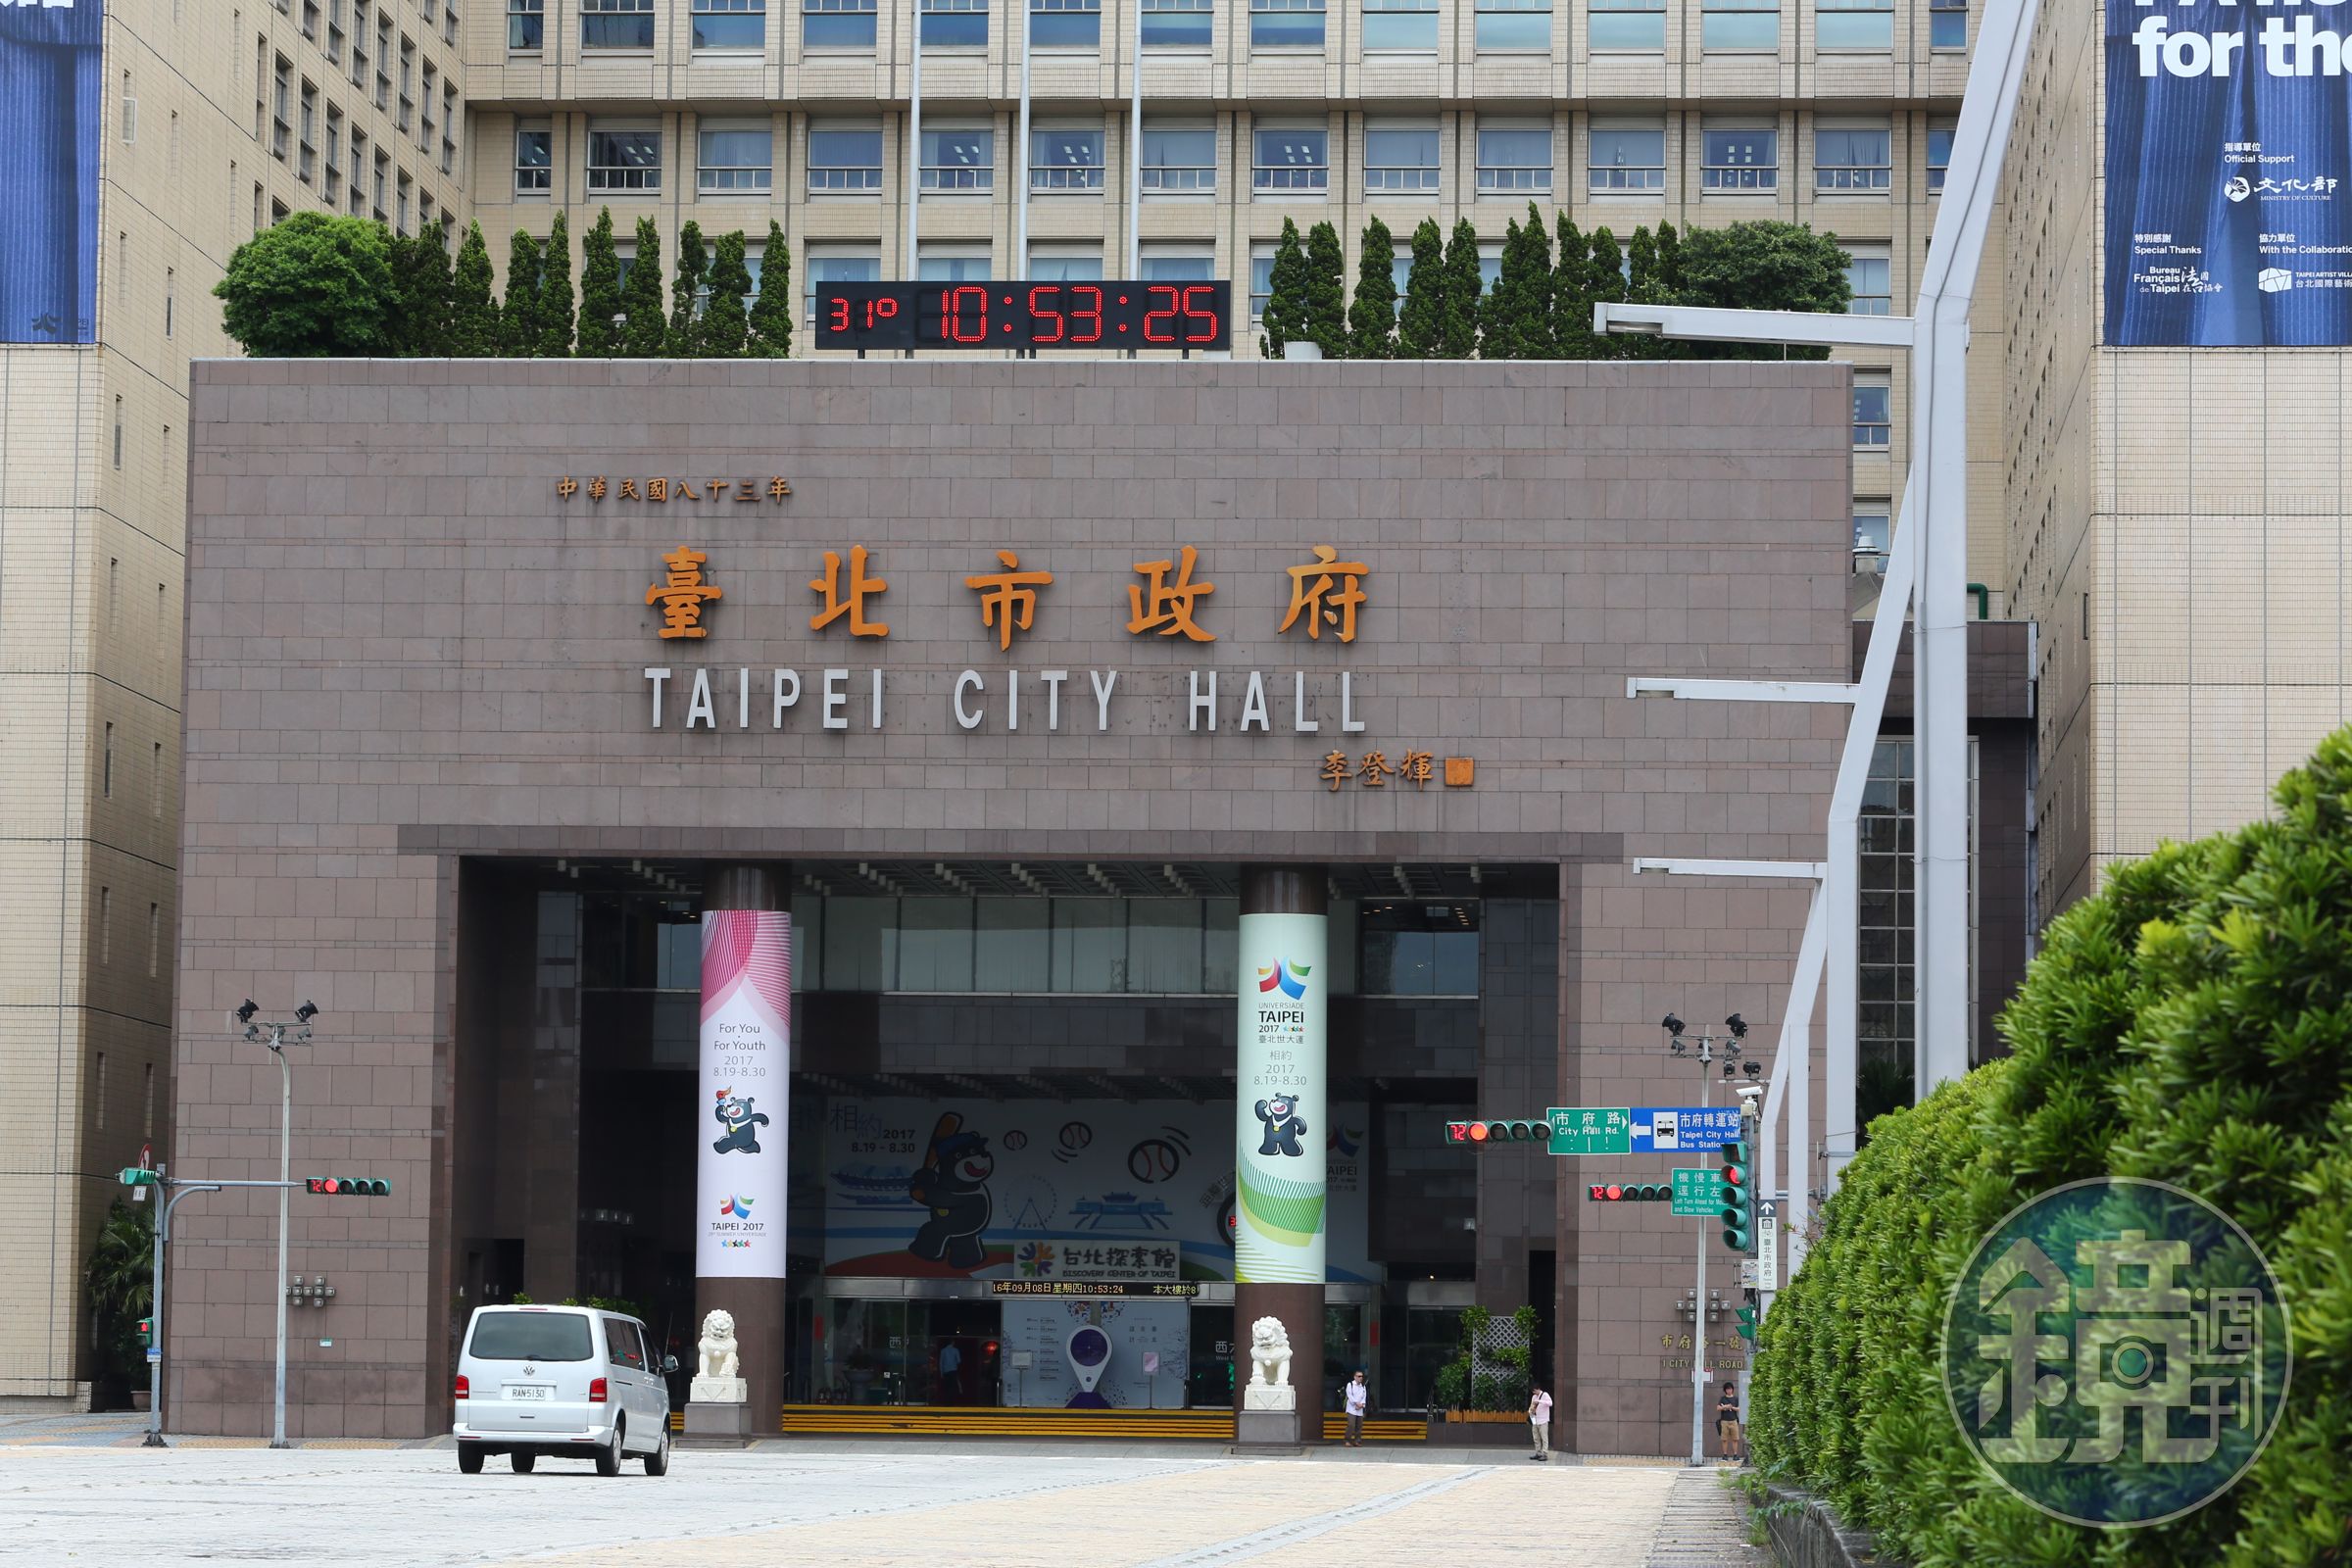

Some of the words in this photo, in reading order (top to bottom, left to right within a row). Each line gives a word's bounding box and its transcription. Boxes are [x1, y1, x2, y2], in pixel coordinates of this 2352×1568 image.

[2132, 15, 2244, 78] for
[2258, 15, 2352, 78] th
[2224, 142, 2262, 152] 指導單位
[2224, 154, 2256, 163] Official
[2258, 154, 2295, 165] Support
[2253, 176, 2338, 194] 文化部
[2134, 233, 2172, 243] 特別感謝
[2259, 233, 2296, 243] 協力單位
[2134, 245, 2168, 255] Special
[2169, 245, 2202, 254] Thanks
[2259, 245, 2280, 254] With
[2281, 245, 2297, 254] the
[2133, 273, 2180, 284] Français
[2150, 283, 2180, 294] Taipei
[941, 285, 1218, 343] 10:53:25
[558, 475, 792, 505] 中華民國八十三年
[645, 544, 1370, 652] 臺北市政府
[645, 667, 882, 729] TAIPEI
[954, 668, 1118, 731] CITY
[1189, 669, 1365, 732] HALL
[1320, 748, 1435, 792] 李登輝
[1257, 1010, 1304, 1023] TAIPEI
[719, 1023, 736, 1034] For
[738, 1023, 760, 1034] You
[1258, 1024, 1280, 1033] 2017
[1258, 1034, 1305, 1045] 臺北世大運
[713, 1040, 730, 1051] For
[732, 1040, 766, 1051] Youth
[723, 1055, 754, 1065] 2017
[1269, 1050, 1293, 1061] 相約
[712, 1066, 766, 1077] 8.19-8.30
[1265, 1063, 1296, 1074] 2017
[1253, 1075, 1307, 1086] 8.19-8.30
[1555, 1111, 1622, 1126] 市府路
[1680, 1112, 1740, 1128] 市府轉運站
[883, 1128, 916, 1140] 2017
[1450, 1124, 1467, 1141] 72
[1558, 1127, 1579, 1137] City
[1680, 1130, 1703, 1140] Taipei
[1705, 1130, 1722, 1140] City
[851, 1142, 877, 1153] 8.19
[888, 1142, 916, 1153] 8.30
[1698, 1140, 1725, 1149] Statio
[1326, 1165, 1357, 1176] AIPEI
[1678, 1172, 1721, 1184] 機慢車
[1591, 1186, 1604, 1200] 72
[710, 1222, 740, 1231] TAIPEI
[742, 1222, 764, 1231] 2017
[1063, 1246, 1176, 1269] 台北探索館
[1669, 1359, 1690, 1368] CITY
[1719, 1359, 1743, 1369] ROAD
[512, 1388, 545, 1398] RAN-5130
